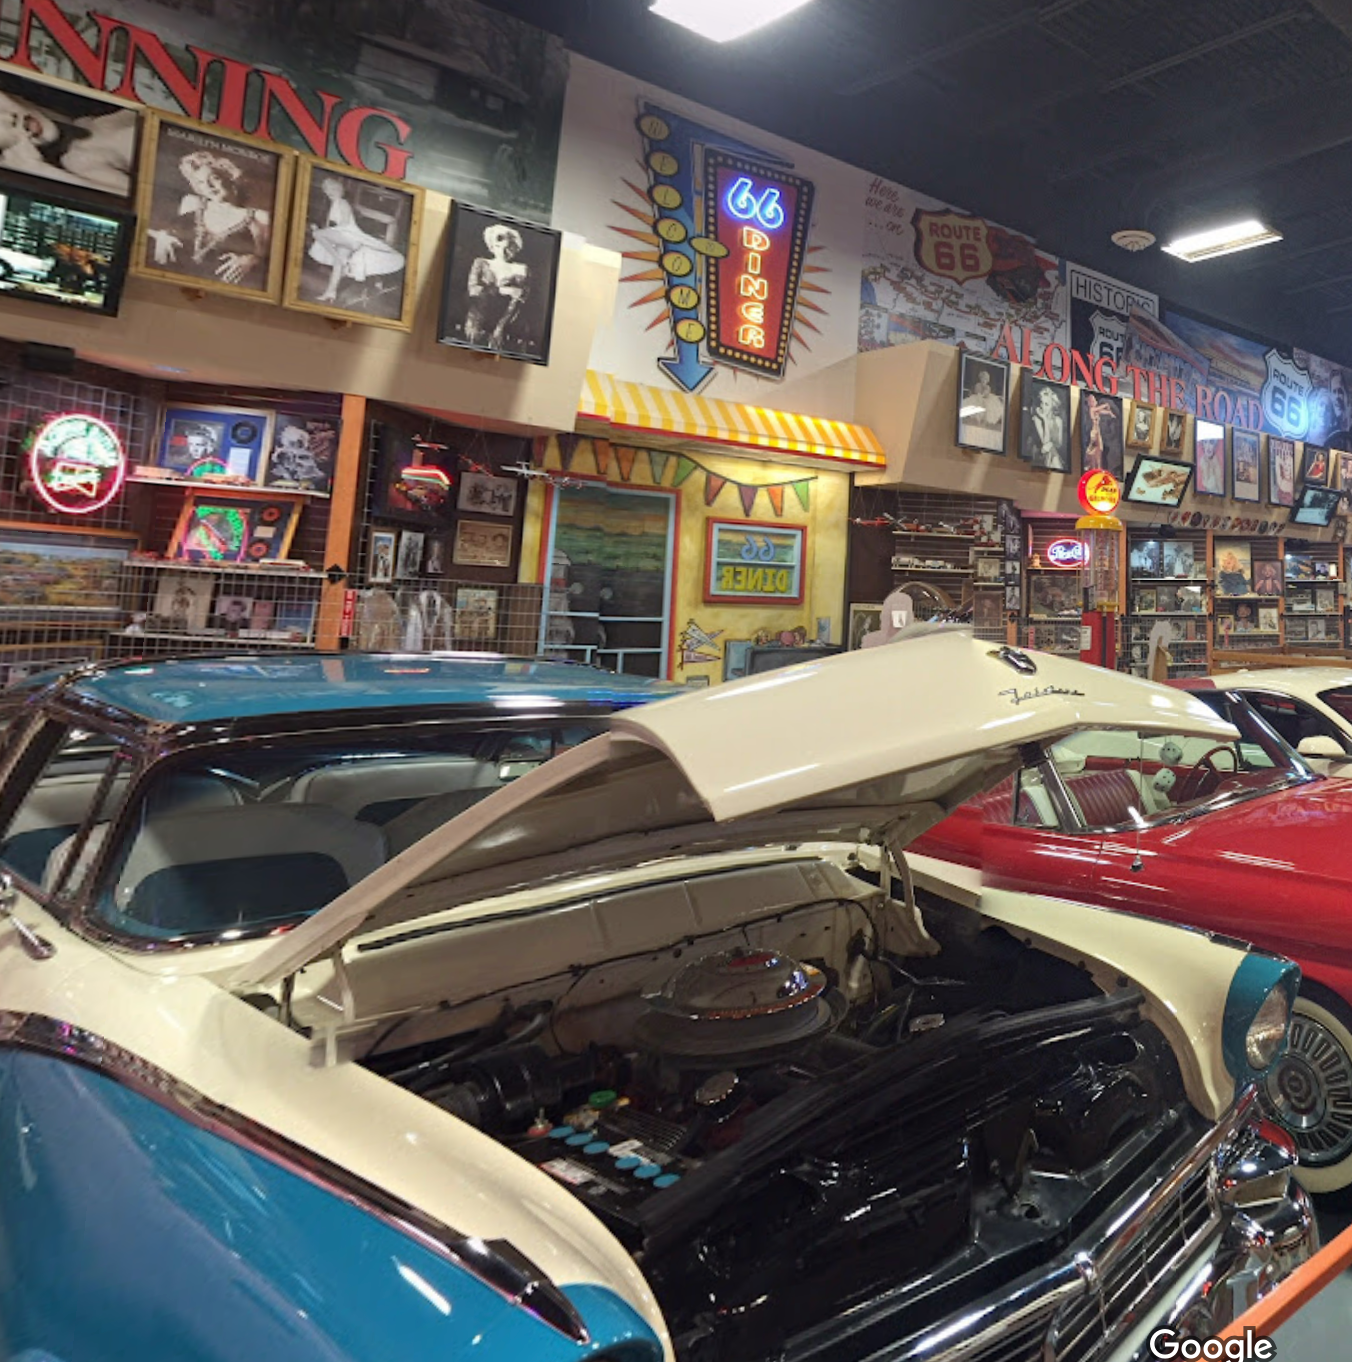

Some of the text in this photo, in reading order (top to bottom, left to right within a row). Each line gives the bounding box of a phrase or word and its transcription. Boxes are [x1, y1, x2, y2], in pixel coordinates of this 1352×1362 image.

[727, 177, 785, 230] 66
[929, 222, 982, 242] ROUTE
[934, 240, 981, 273] 66
[738, 225, 771, 349] DINER
[1076, 276, 1152, 313] HISTOR
[1098, 326, 1127, 342] ROUT
[991, 321, 1266, 432] ALONG THE ROAD
[1272, 368, 1304, 398] ROUTE
[1270, 385, 1302, 429] 66
